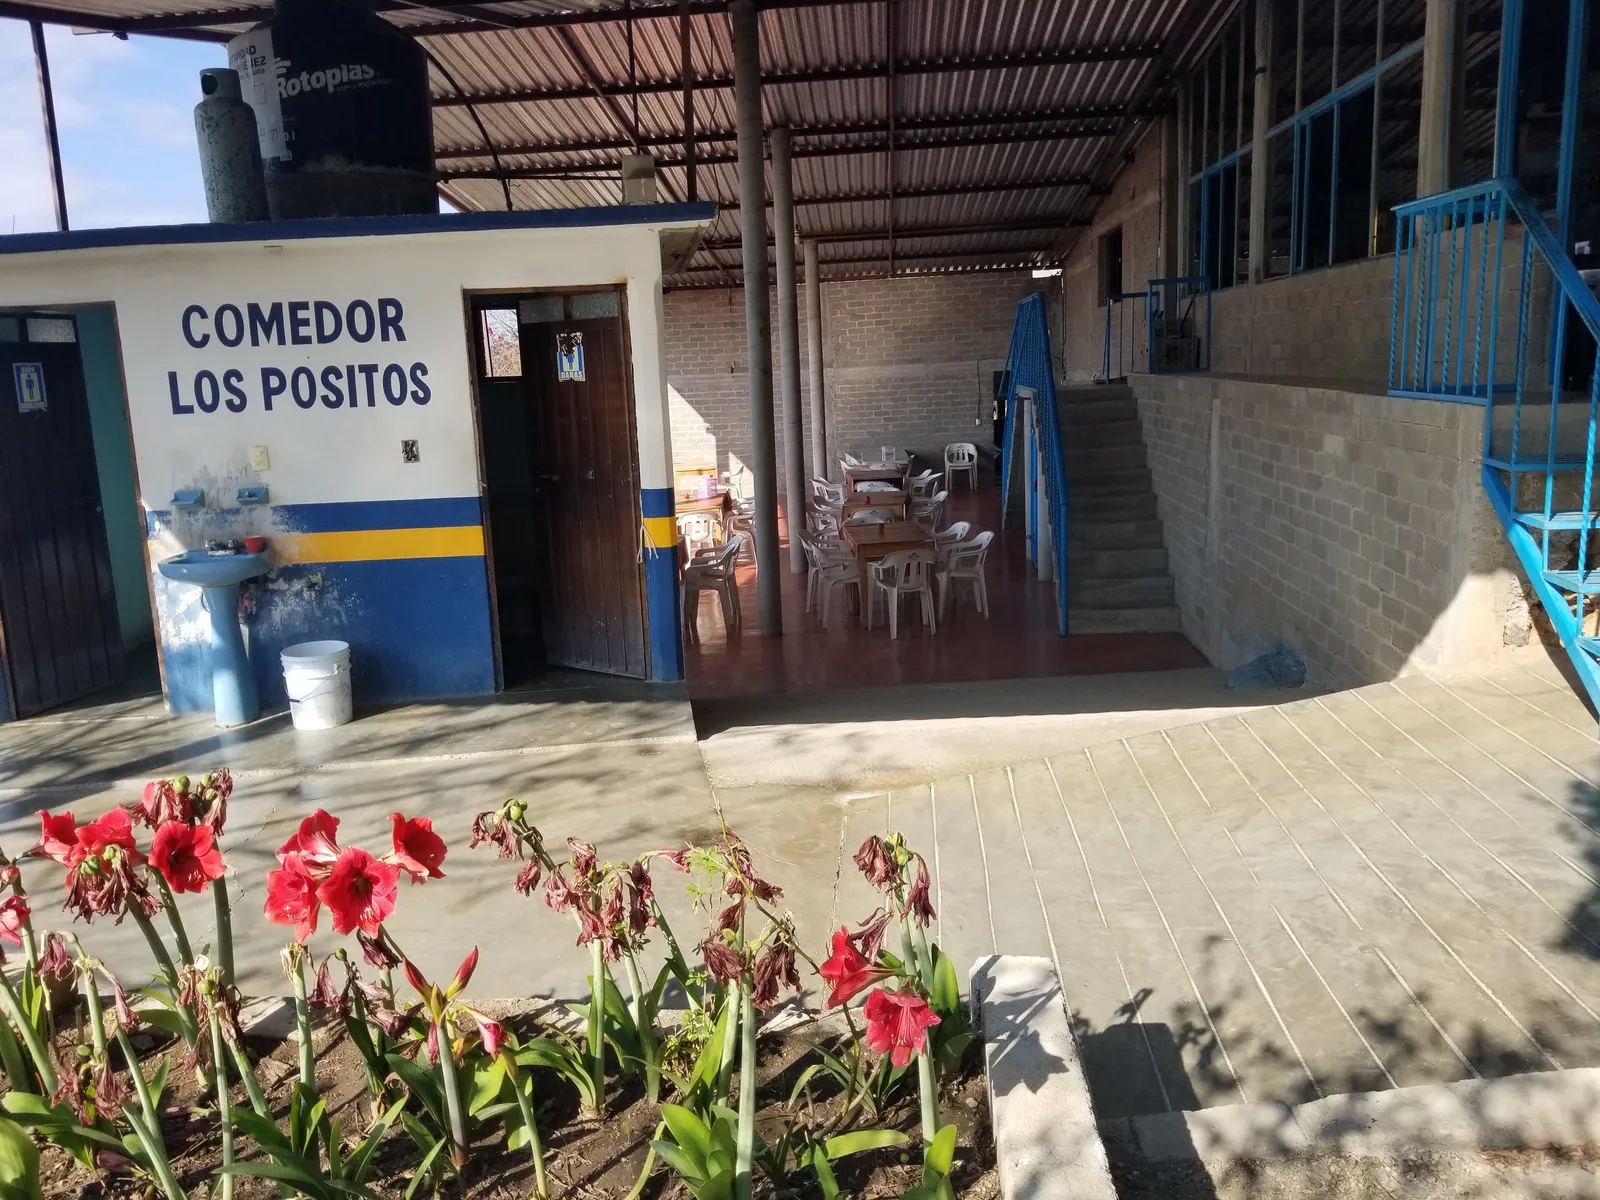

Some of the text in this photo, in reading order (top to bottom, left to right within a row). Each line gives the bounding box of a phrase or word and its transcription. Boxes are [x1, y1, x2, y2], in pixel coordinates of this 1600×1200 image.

[276, 64, 375, 98] Rotoplas
[181, 297, 407, 349] COMEDOR
[168, 362, 432, 415] LOS POSITOS
[560, 371, 583, 379] DAMAS
